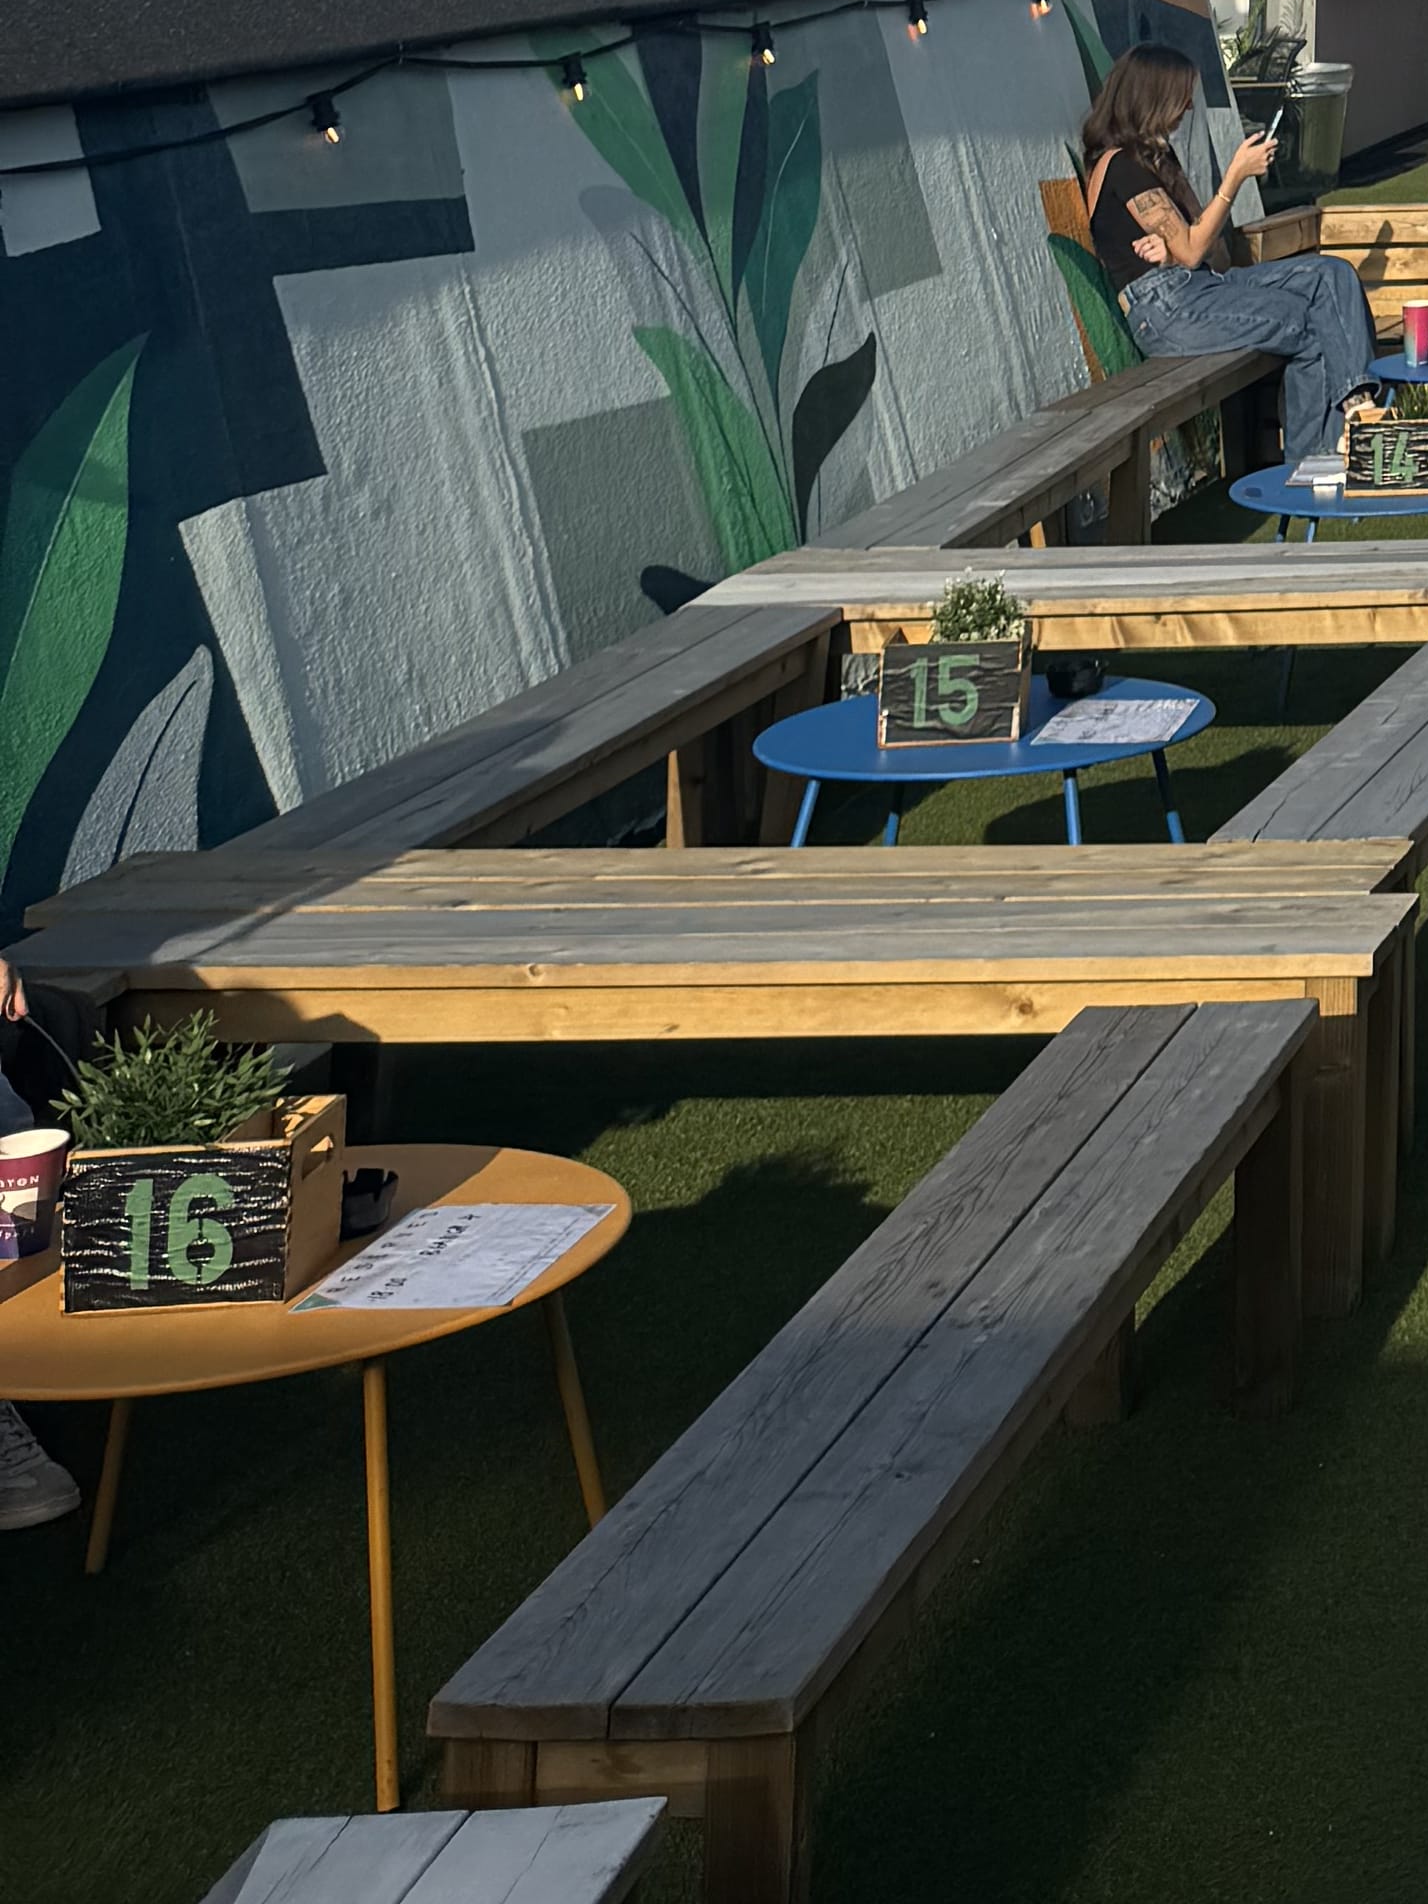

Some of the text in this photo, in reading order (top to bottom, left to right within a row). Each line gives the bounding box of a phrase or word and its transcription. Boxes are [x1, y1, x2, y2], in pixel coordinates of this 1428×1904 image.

[1371, 431, 1419, 485] 14
[910, 654, 979, 728] 15
[125, 1173, 234, 1290] 16
